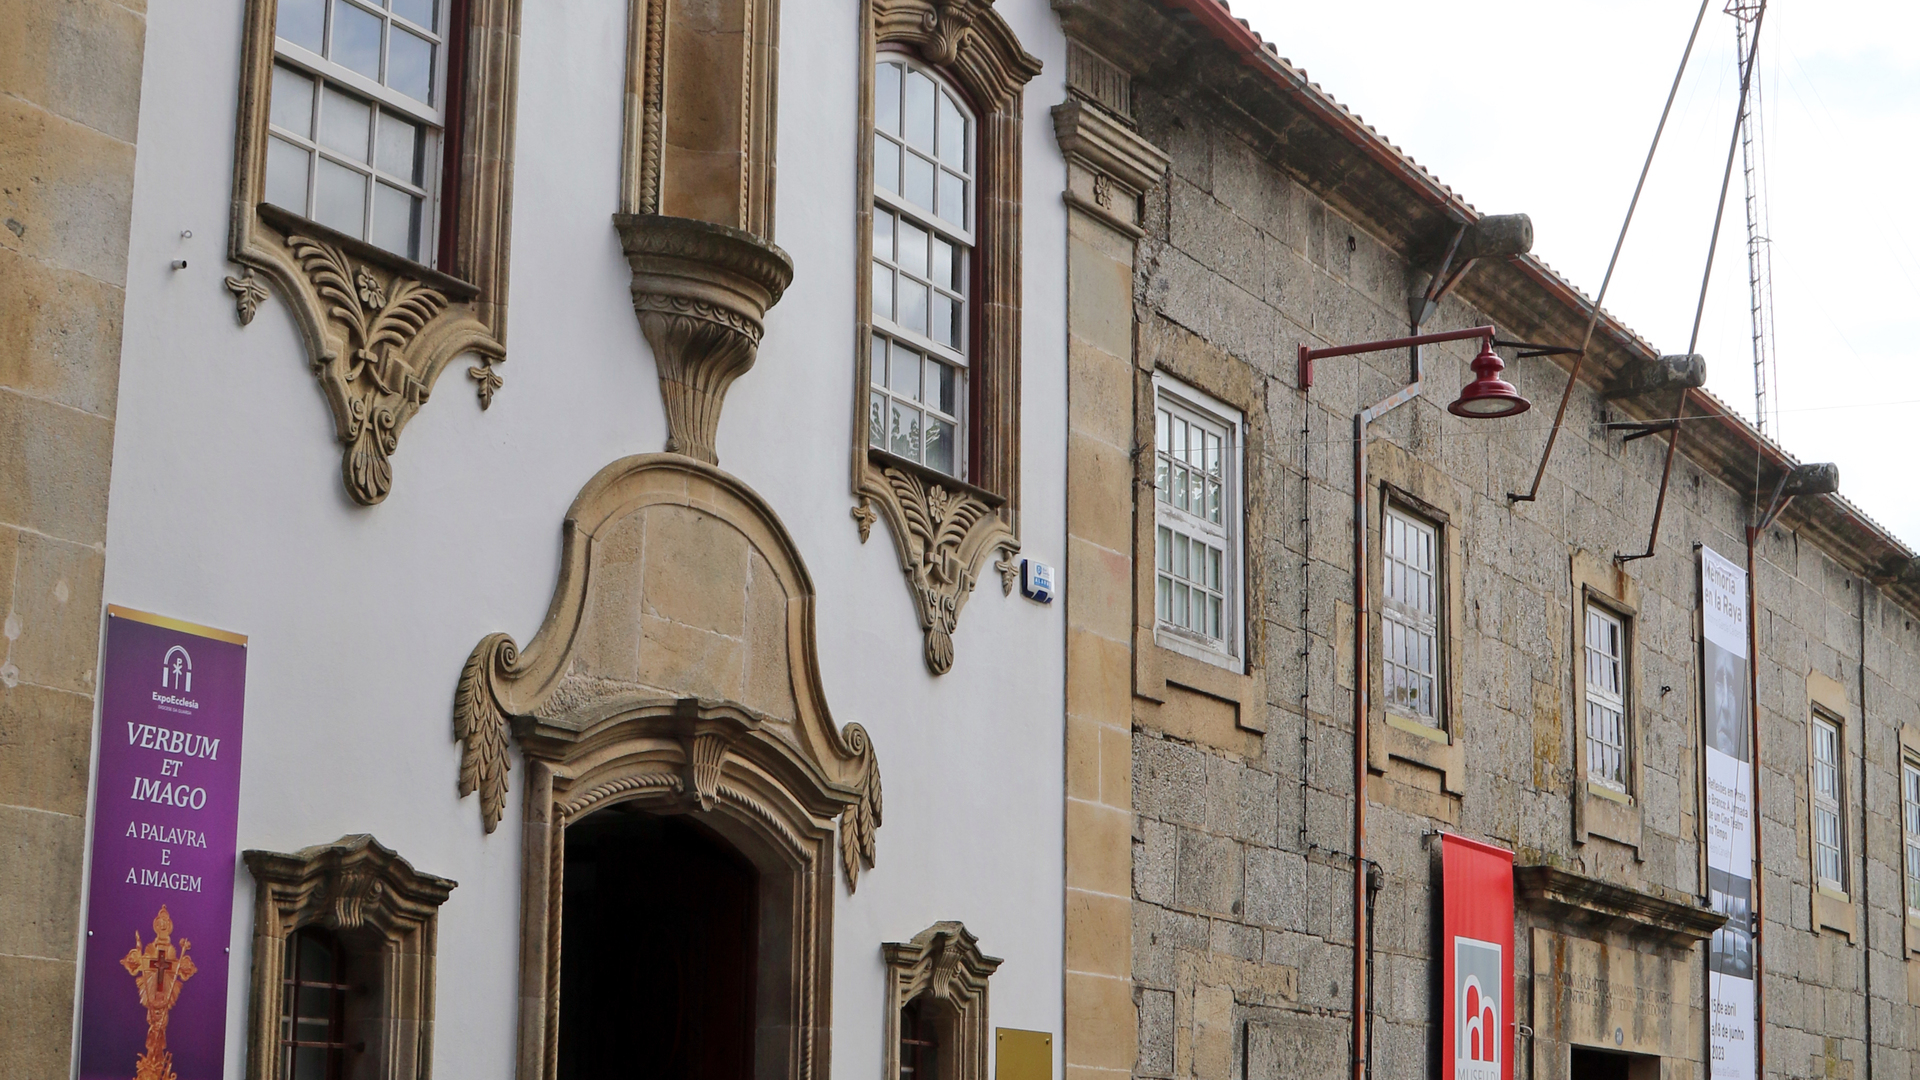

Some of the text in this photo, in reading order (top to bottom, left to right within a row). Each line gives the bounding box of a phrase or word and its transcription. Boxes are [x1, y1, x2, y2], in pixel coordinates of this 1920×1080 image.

[1704, 587, 1742, 625] en la Raya
[152, 691, 199, 709] ExpoEcclesia
[127, 721, 221, 761] VERBUM
[160, 758, 184, 778] ET
[130, 776, 207, 810] IMAGO
[125, 820, 207, 849] A PALAVRA
[161, 848, 171, 866] E
[125, 867, 202, 893] A IMAGEM
[1711, 998, 1717, 1013] 15
[1724, 1001, 1737, 1017] abril
[1722, 1023, 1728, 1038] de
[1728, 1024, 1745, 1043] junho
[1712, 1045, 1725, 1061] 2023
